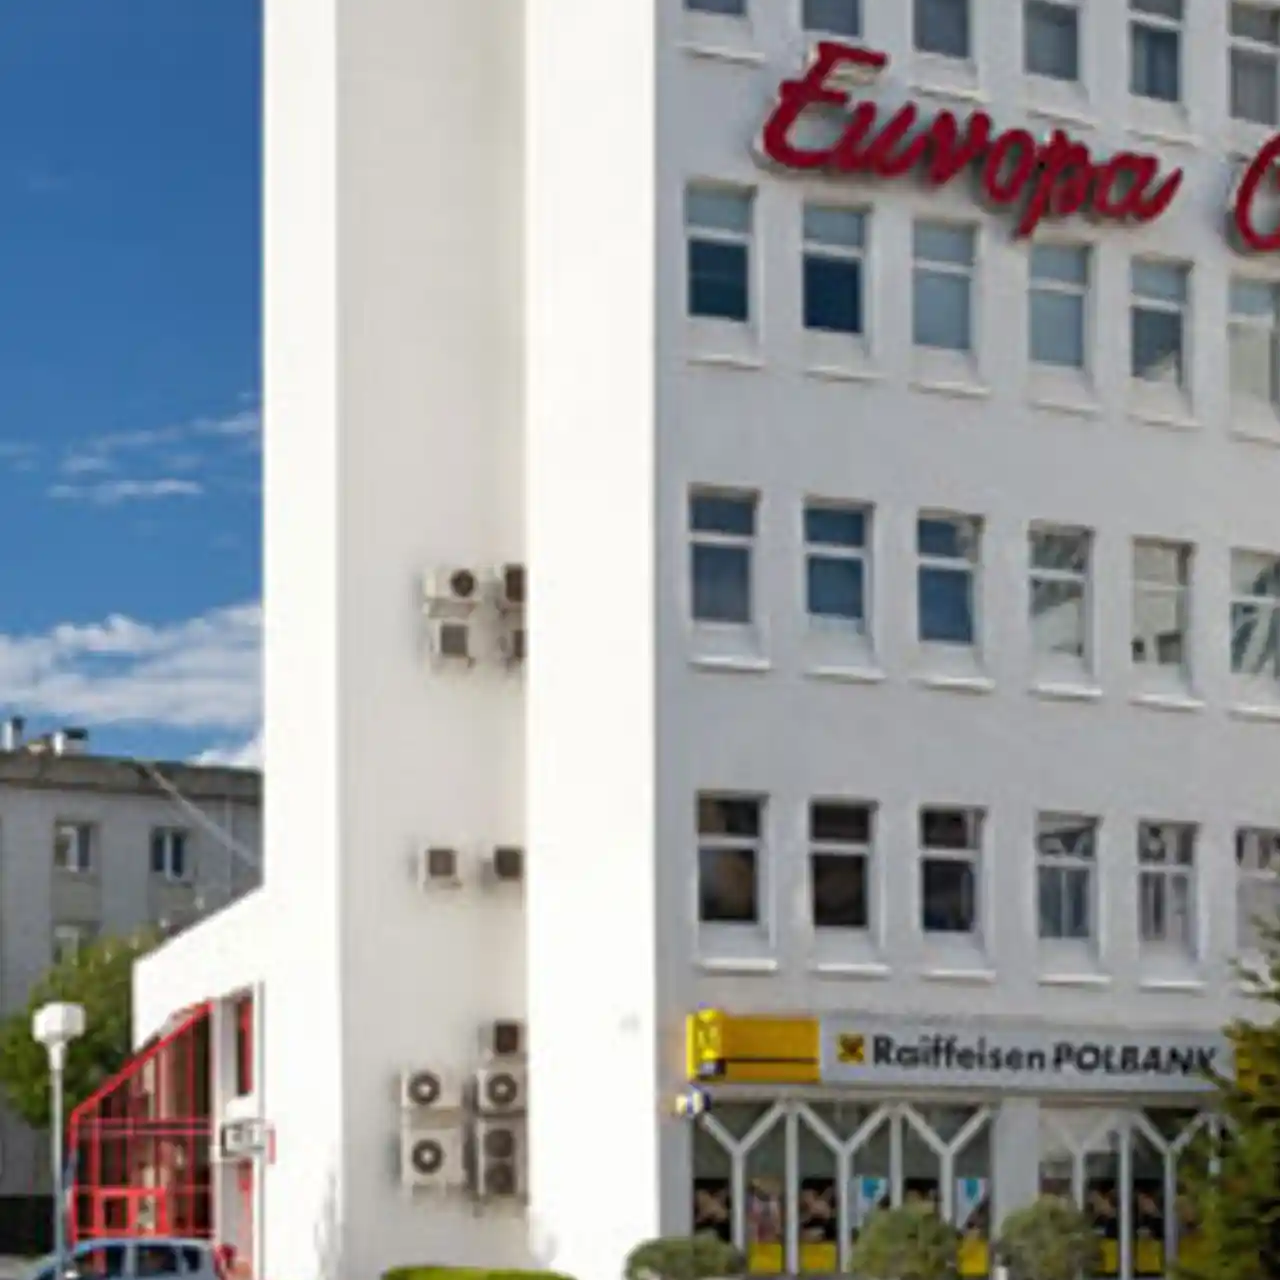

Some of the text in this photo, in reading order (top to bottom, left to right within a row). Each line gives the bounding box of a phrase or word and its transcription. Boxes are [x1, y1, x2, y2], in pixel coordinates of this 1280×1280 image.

[763, 41, 1184, 239] Europa
[872, 1034, 1217, 1076] Raiffeisen POLBANK
